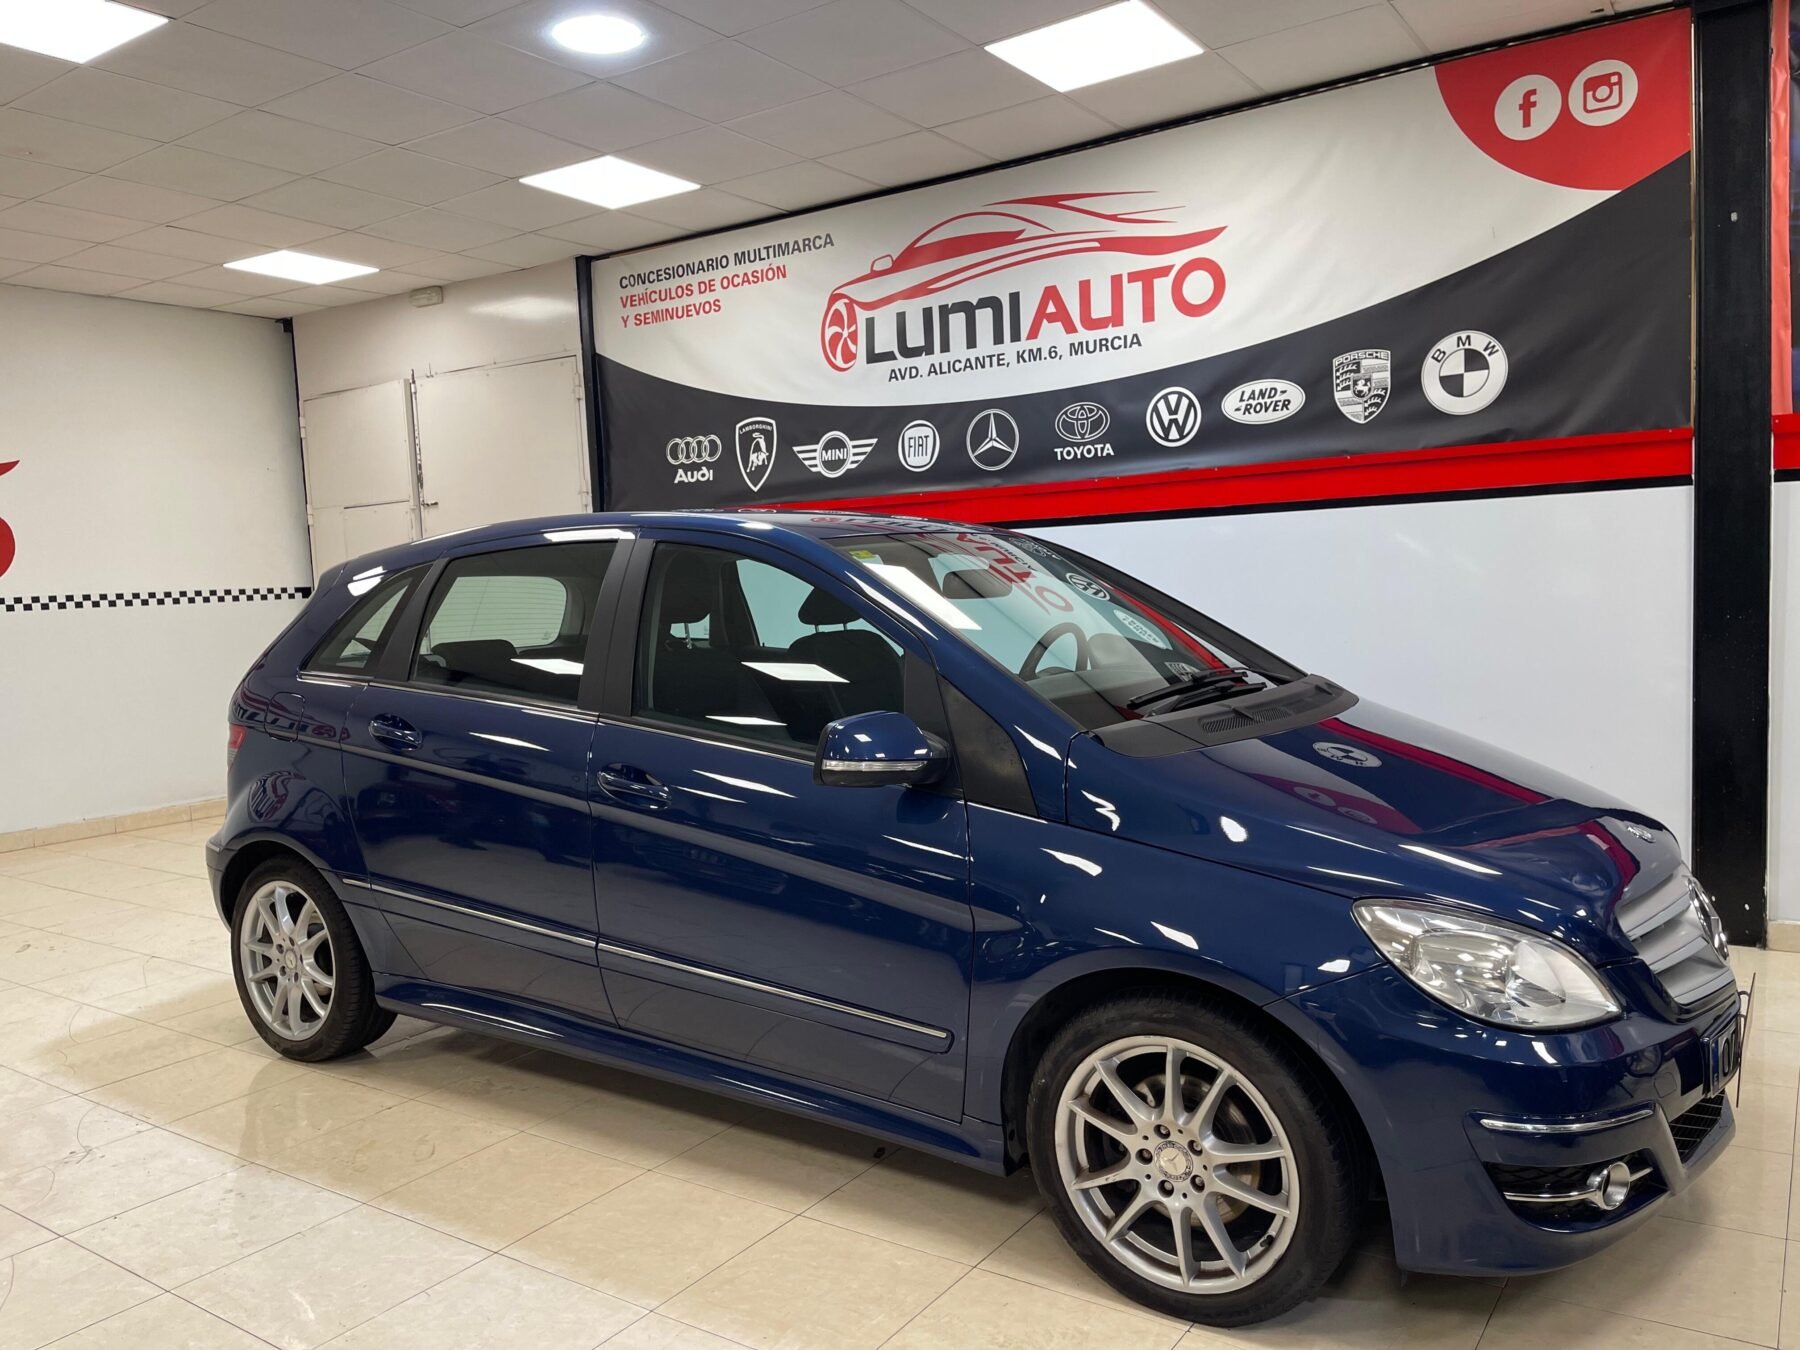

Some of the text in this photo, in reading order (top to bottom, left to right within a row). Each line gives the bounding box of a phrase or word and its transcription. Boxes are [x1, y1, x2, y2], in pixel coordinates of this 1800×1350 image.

[619, 233, 835, 289] CONCESIONARIO MULTIMARCA
[620, 263, 787, 309] VEHÍCULOS DE OCASIÓN
[621, 299, 722, 328] Y SEMINUEVOS
[887, 333, 1143, 383] AVD. ALICANTE, KM.6, MURCIA
[1335, 351, 1389, 366] PORSCHE
[1432, 335, 1499, 363] BMW
[821, 447, 848, 462] MINI
[907, 434, 930, 458] FIAT
[1054, 443, 1115, 461] TOYOTA
[674, 466, 713, 484] Audi
